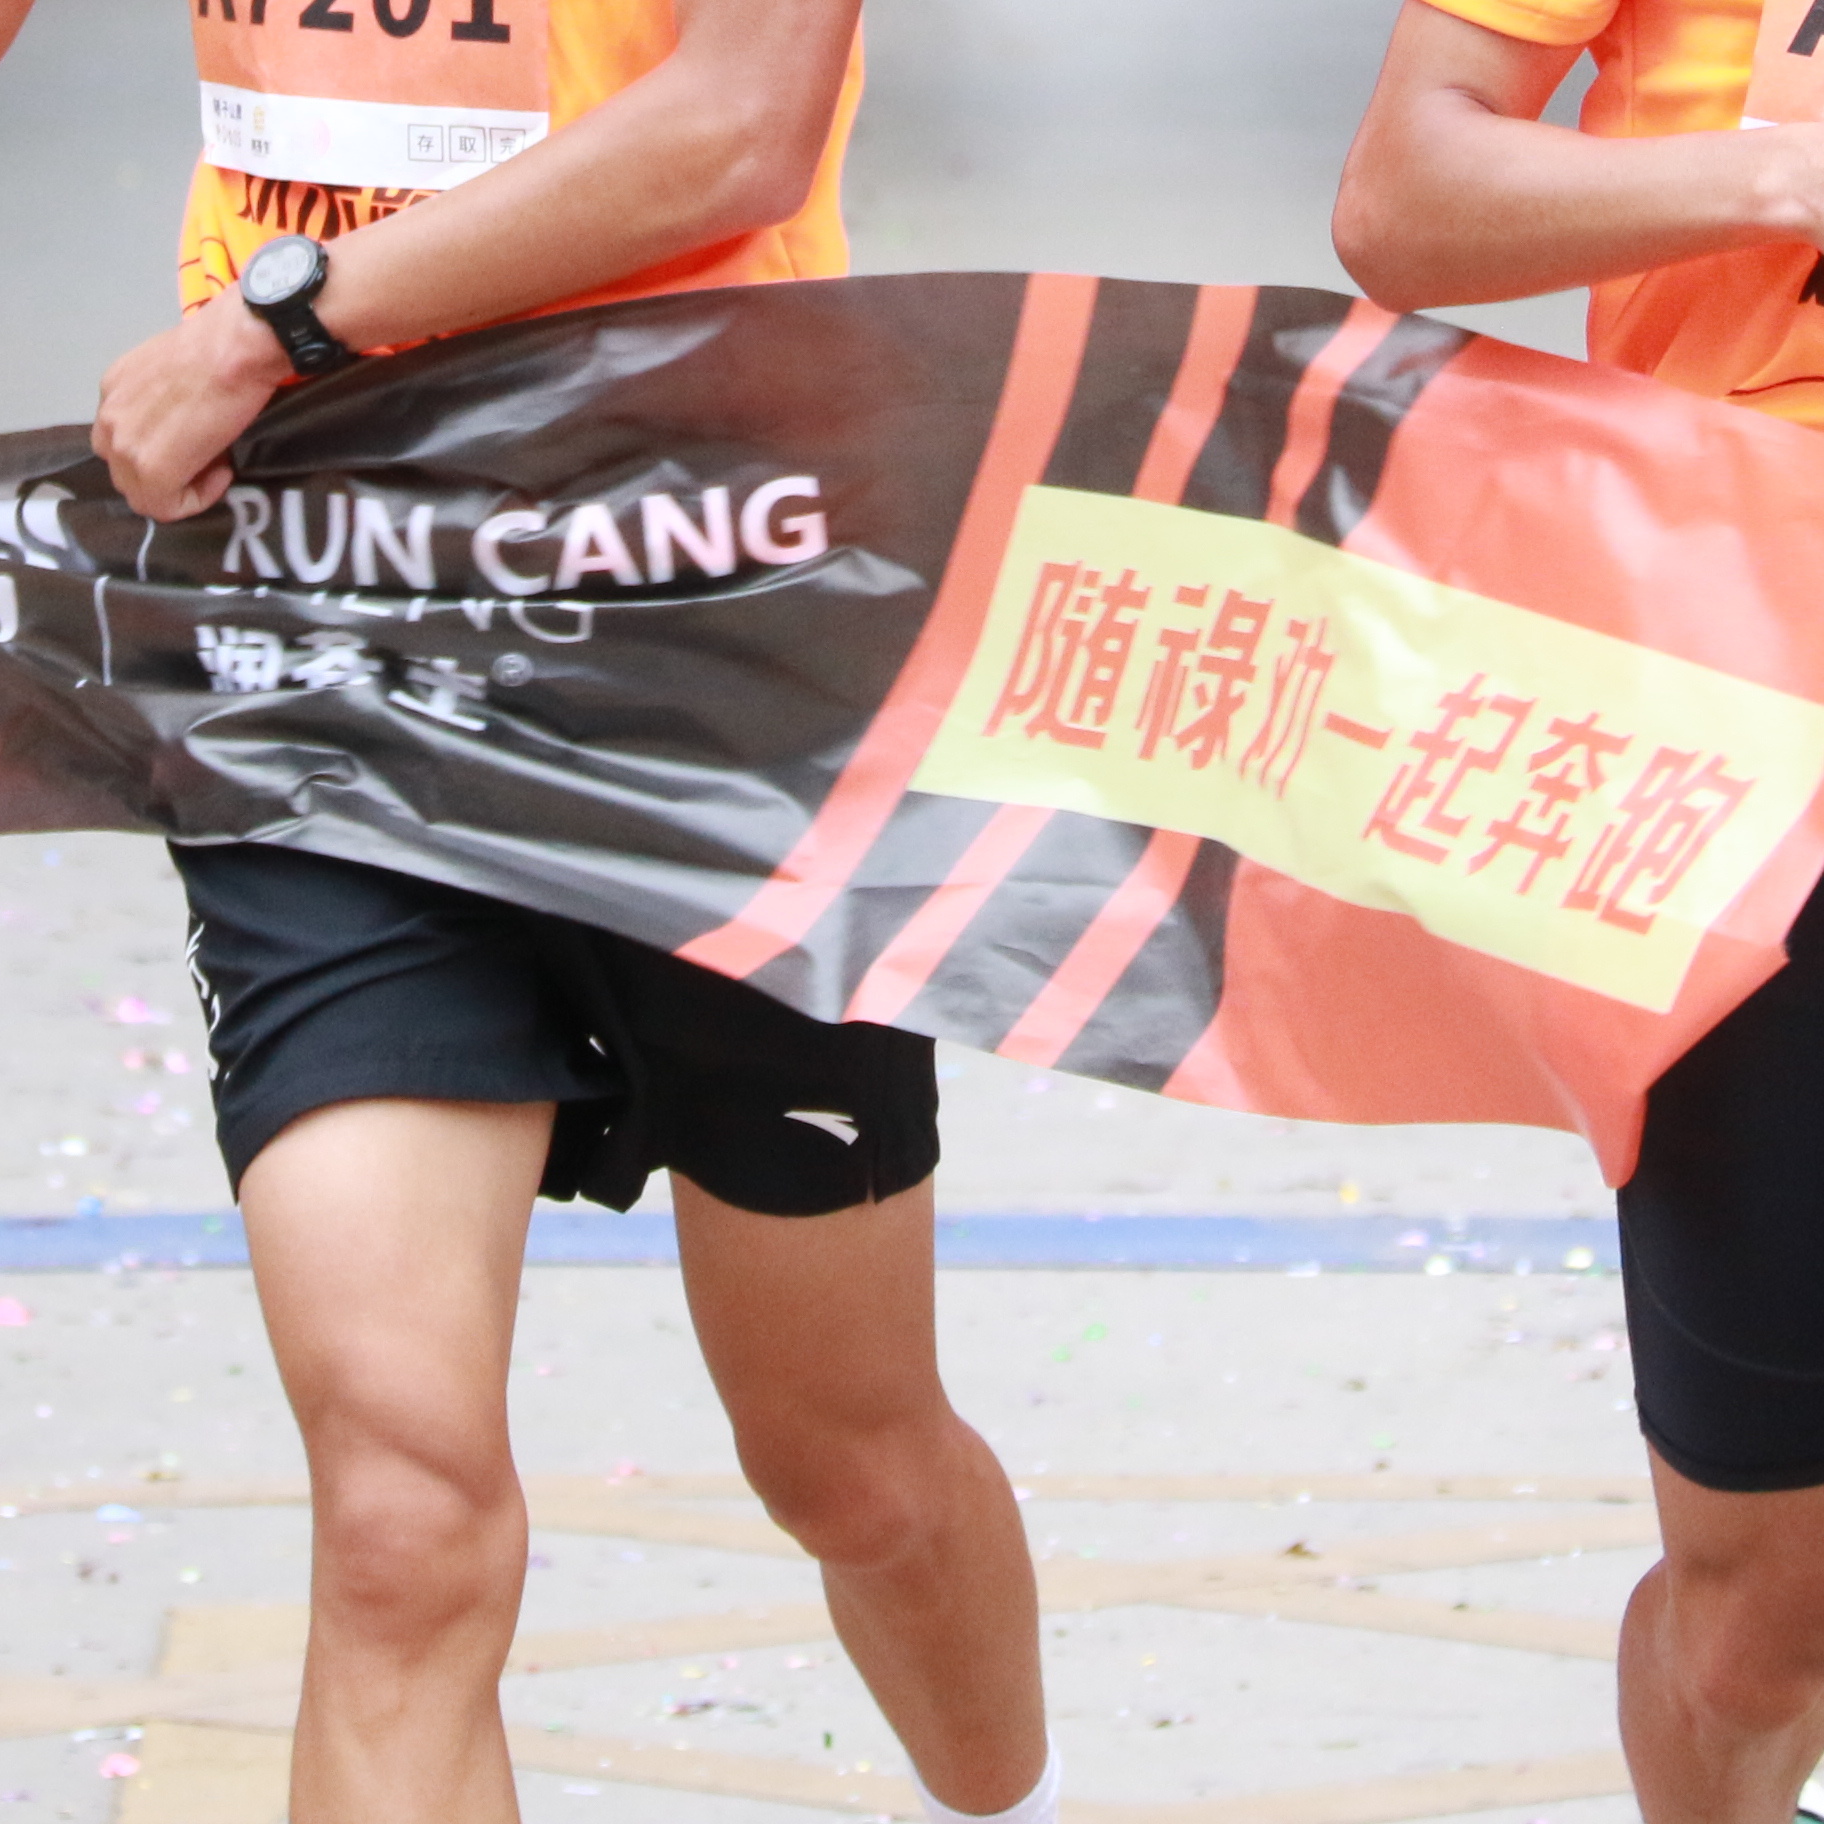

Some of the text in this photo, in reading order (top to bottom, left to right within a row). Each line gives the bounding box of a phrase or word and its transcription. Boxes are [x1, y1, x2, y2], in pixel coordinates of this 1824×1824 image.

[416, 134, 434, 153] 存
[458, 135, 476, 153] 取
[499, 137, 517, 155] 完
[222, 473, 827, 597] RUN CANG
[982, 557, 1757, 937] 随禄劝一起奔跑
